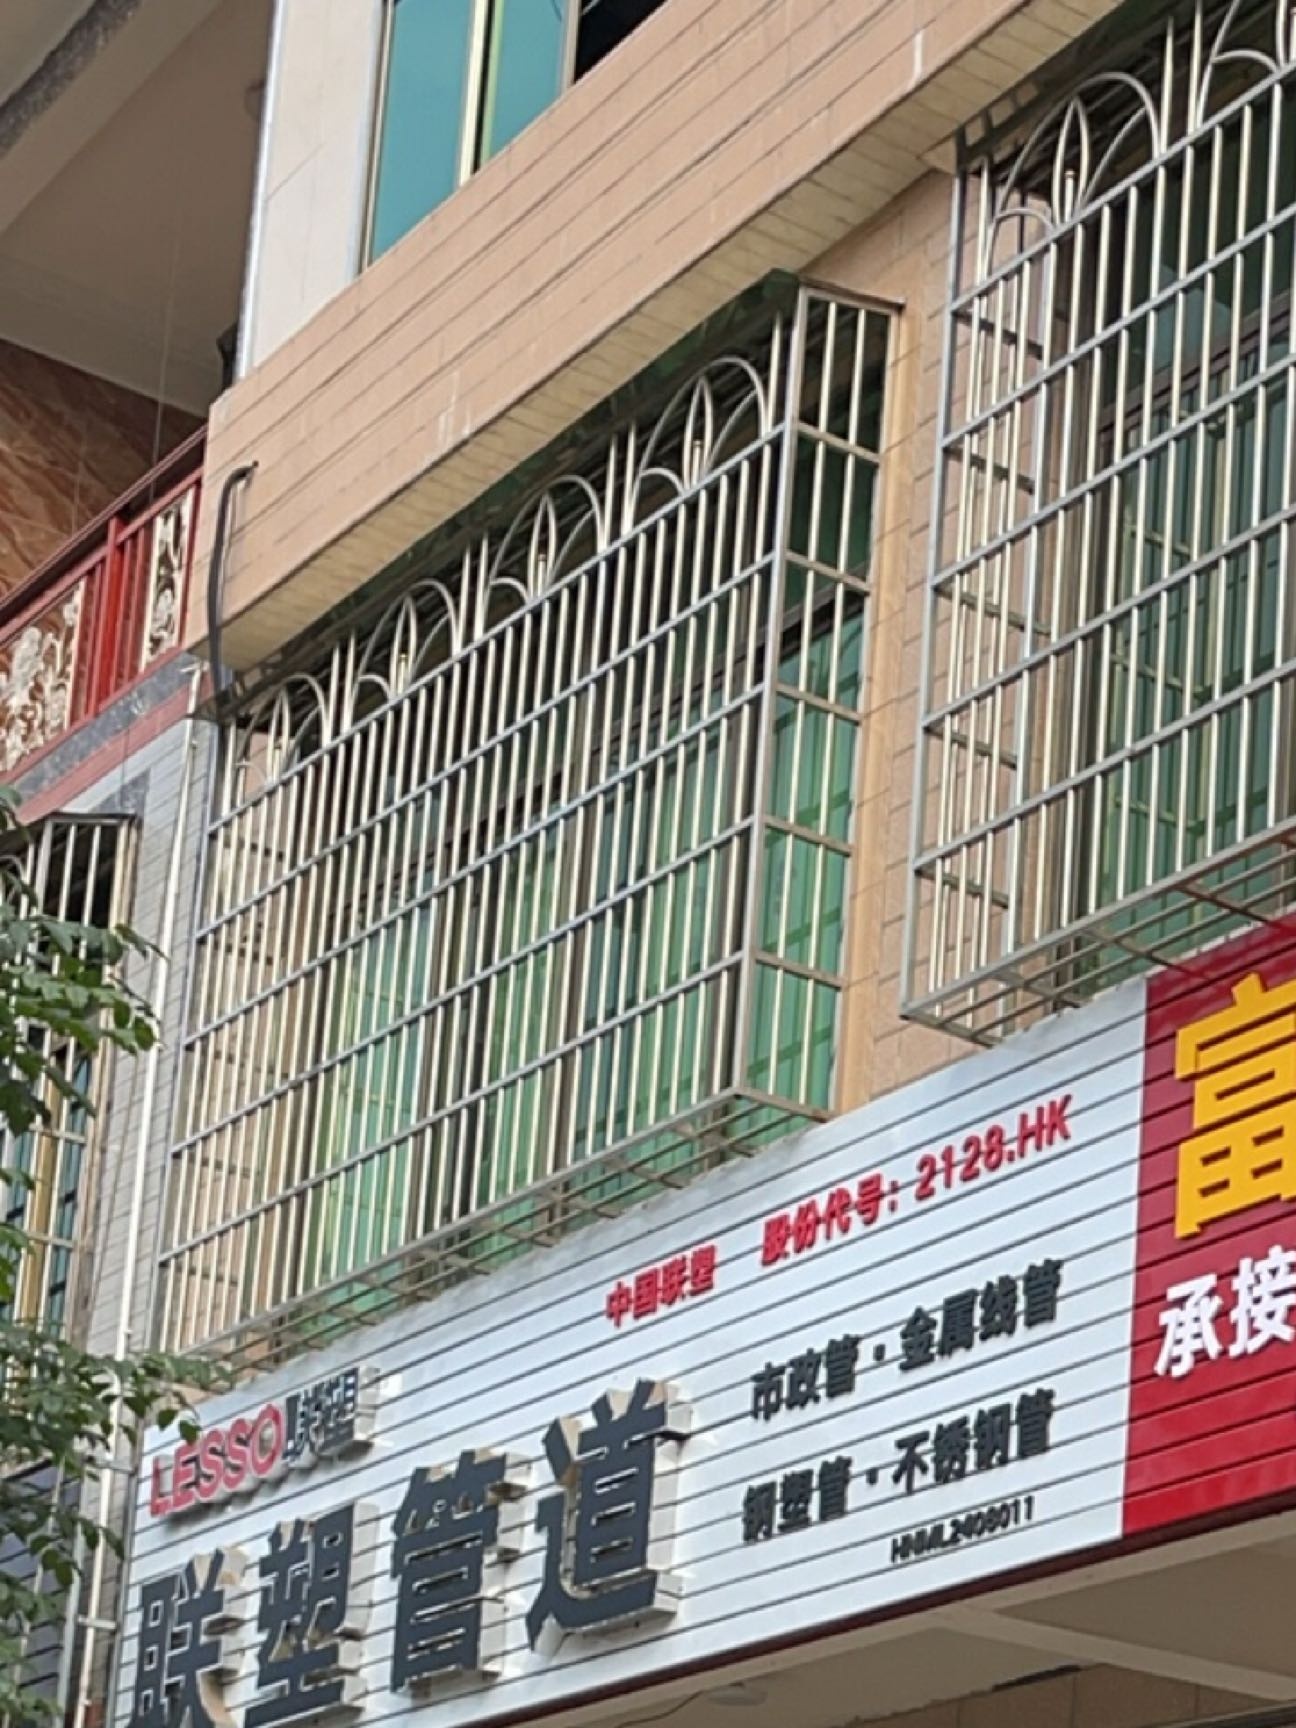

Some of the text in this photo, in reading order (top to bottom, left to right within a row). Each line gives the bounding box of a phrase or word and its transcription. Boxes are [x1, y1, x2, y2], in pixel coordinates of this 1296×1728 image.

[605, 1244, 718, 1327] 中国联塑
[149, 1401, 286, 1518] LESSO
